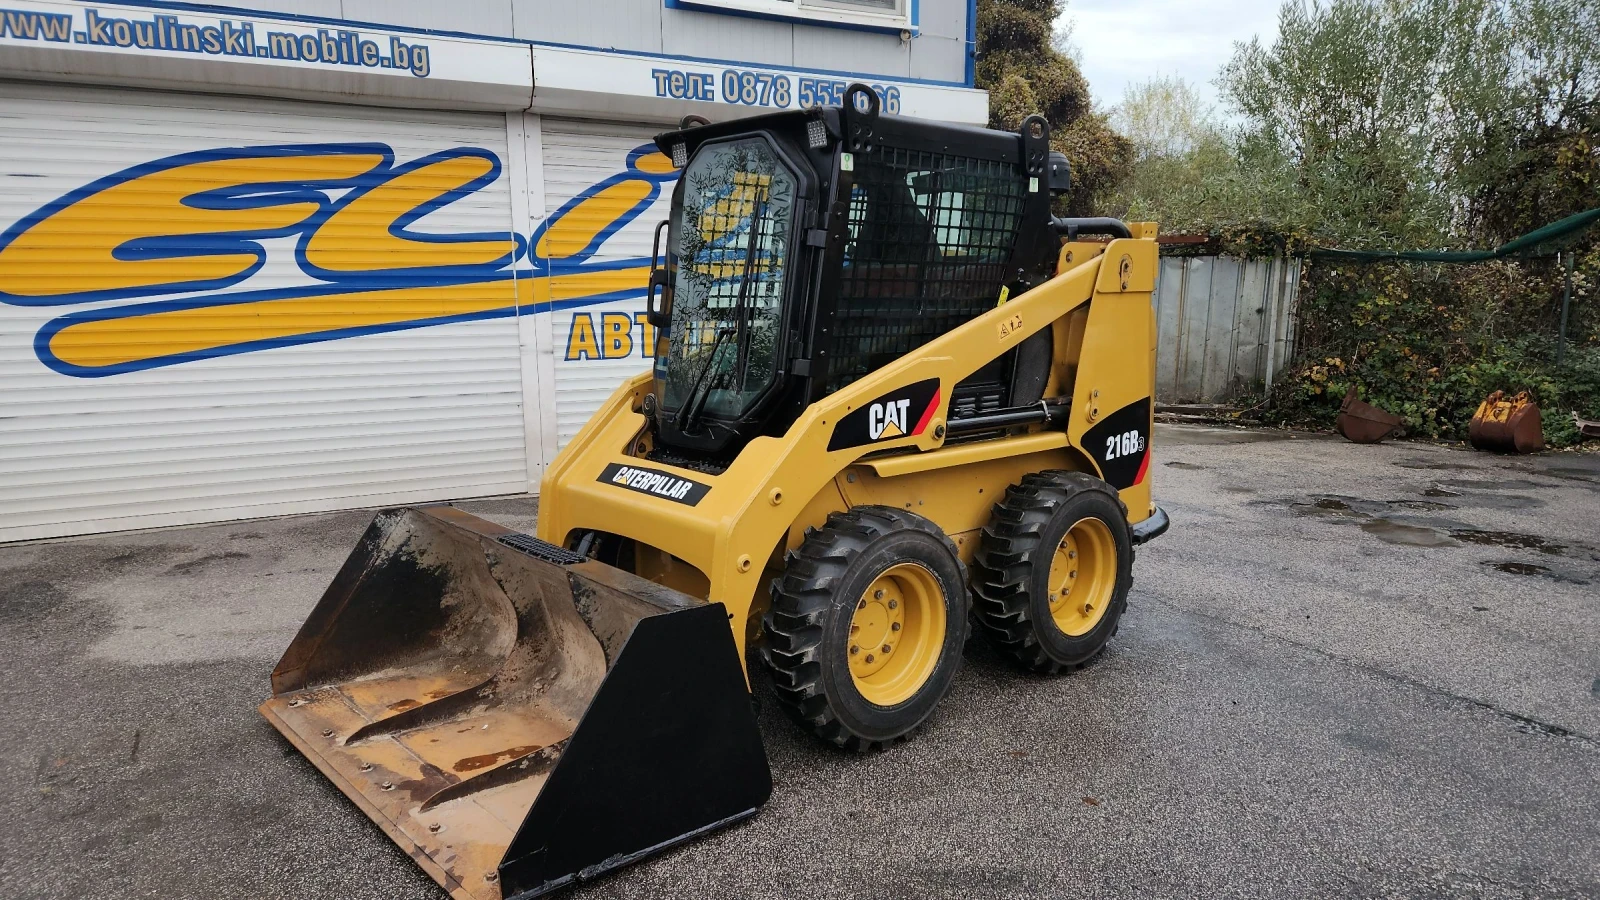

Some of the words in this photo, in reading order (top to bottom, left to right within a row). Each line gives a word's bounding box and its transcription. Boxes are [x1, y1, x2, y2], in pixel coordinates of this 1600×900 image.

[0, 8, 430, 78] ww.koulinski.mobile.bg
[652, 68, 715, 101] тел:
[722, 69, 791, 108] 0878
[799, 78, 846, 109] 555
[565, 311, 656, 361] АВТ
[869, 398, 910, 440] CAT
[612, 466, 693, 500] CATERPILLAR
